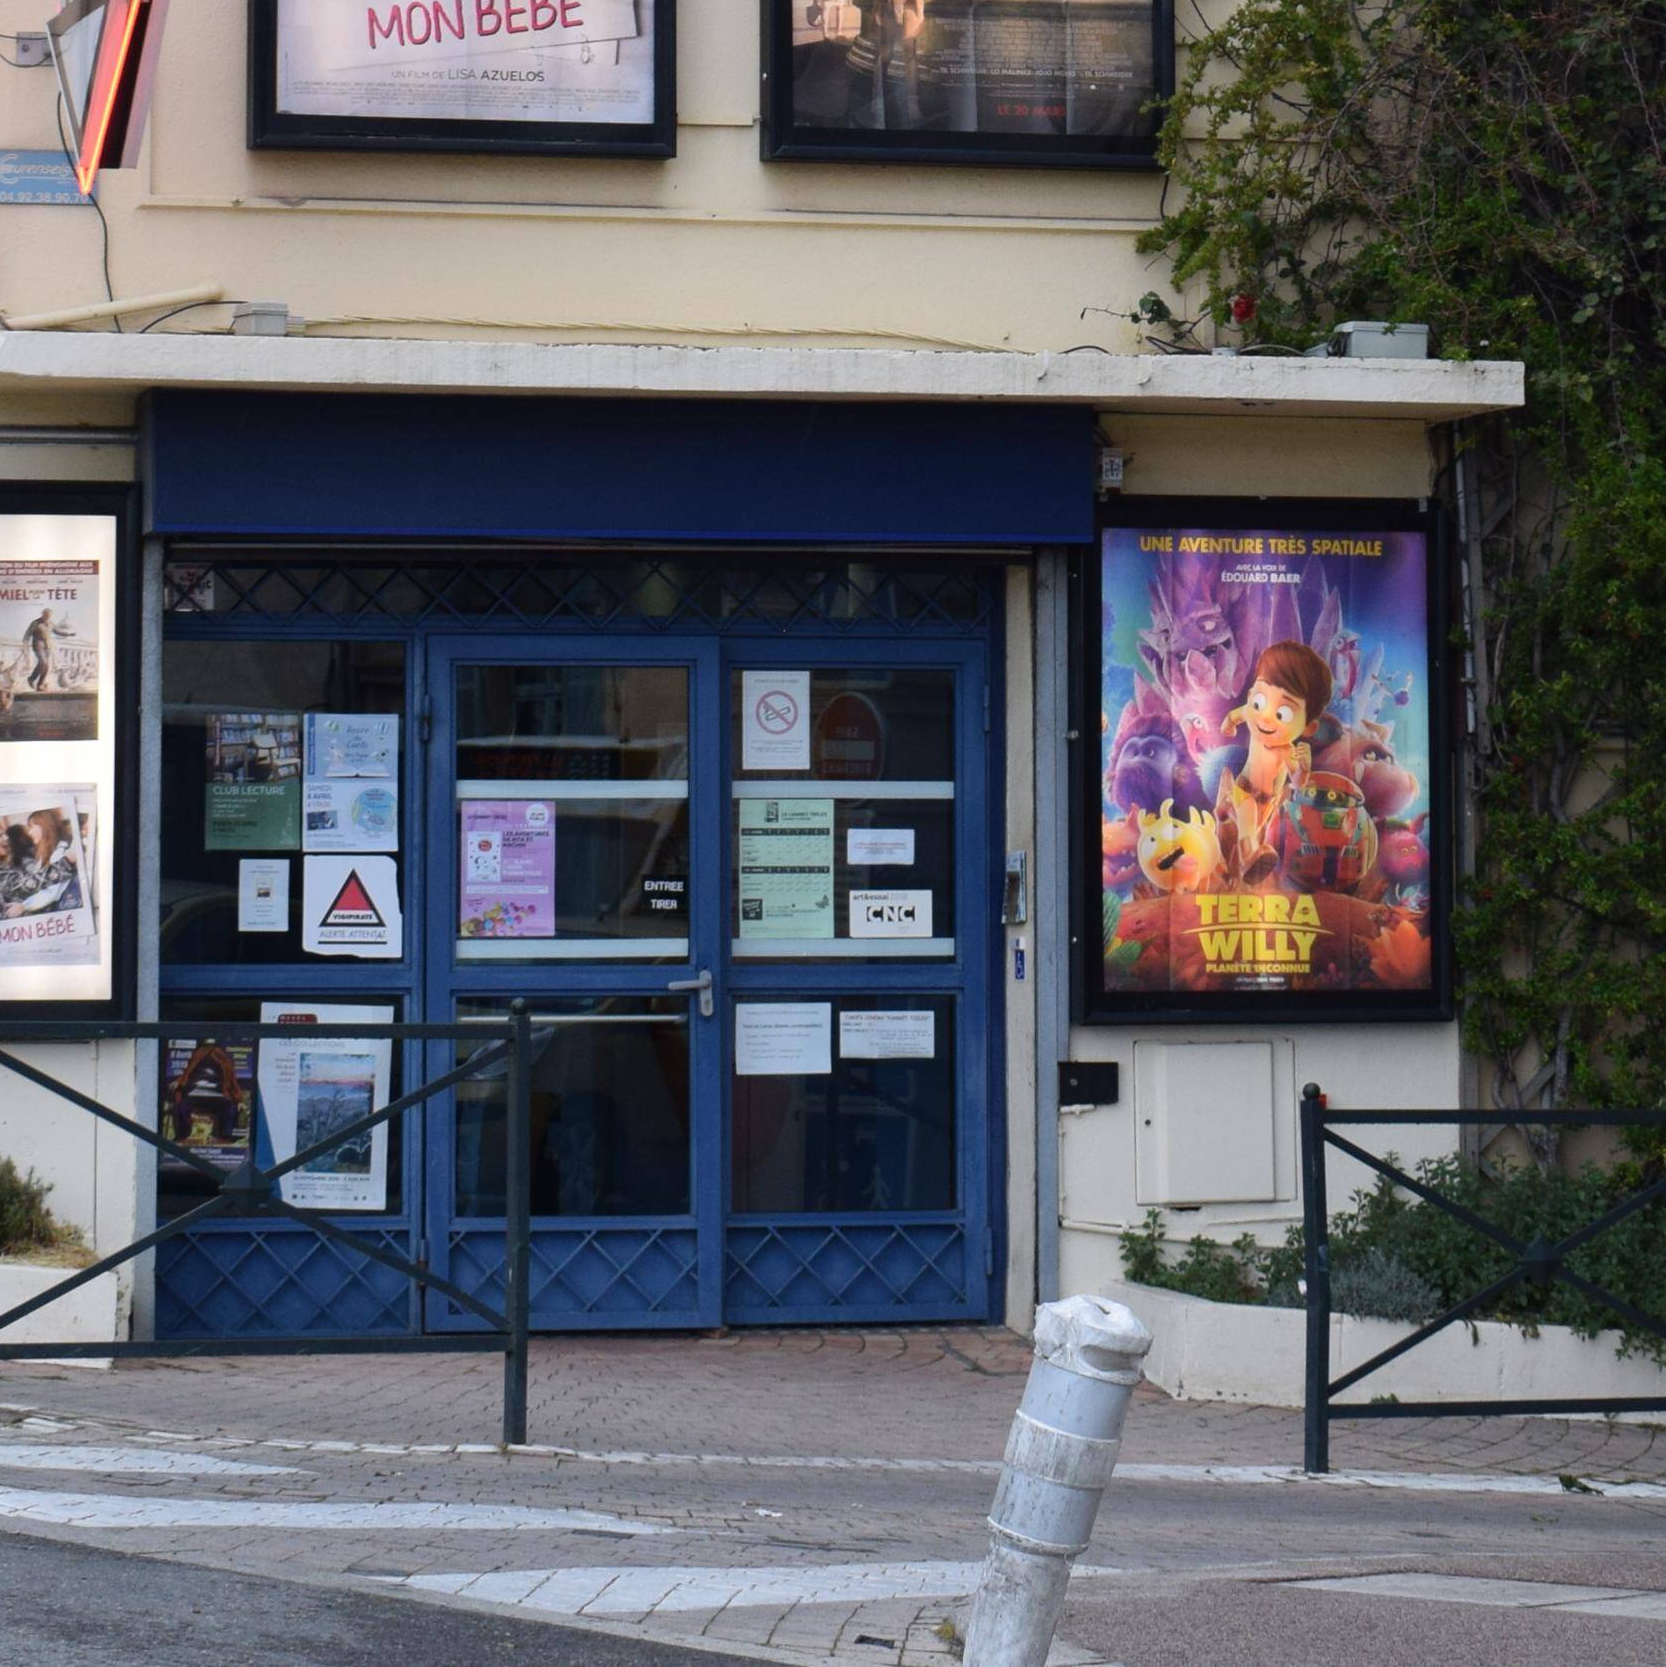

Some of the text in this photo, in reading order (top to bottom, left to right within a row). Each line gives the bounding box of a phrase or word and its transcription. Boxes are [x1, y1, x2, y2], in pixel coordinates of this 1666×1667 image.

[391, 68, 545, 83] UN FILM DE LISA AZUELOS
[1140, 535, 1382, 556] UNE AVENTURE TRÈS SPATIALE
[1221, 570, 1301, 583] ÉDOUARD BAER
[213, 786, 285, 796] CLUB LECTURE
[644, 881, 684, 892] ENTREE
[651, 899, 677, 909] TIRER
[1195, 894, 1321, 926] TERRA
[866, 906, 916, 922] CNC
[36, 913, 76, 938] BÉBÉ
[1198, 929, 1318, 961] WILLY
